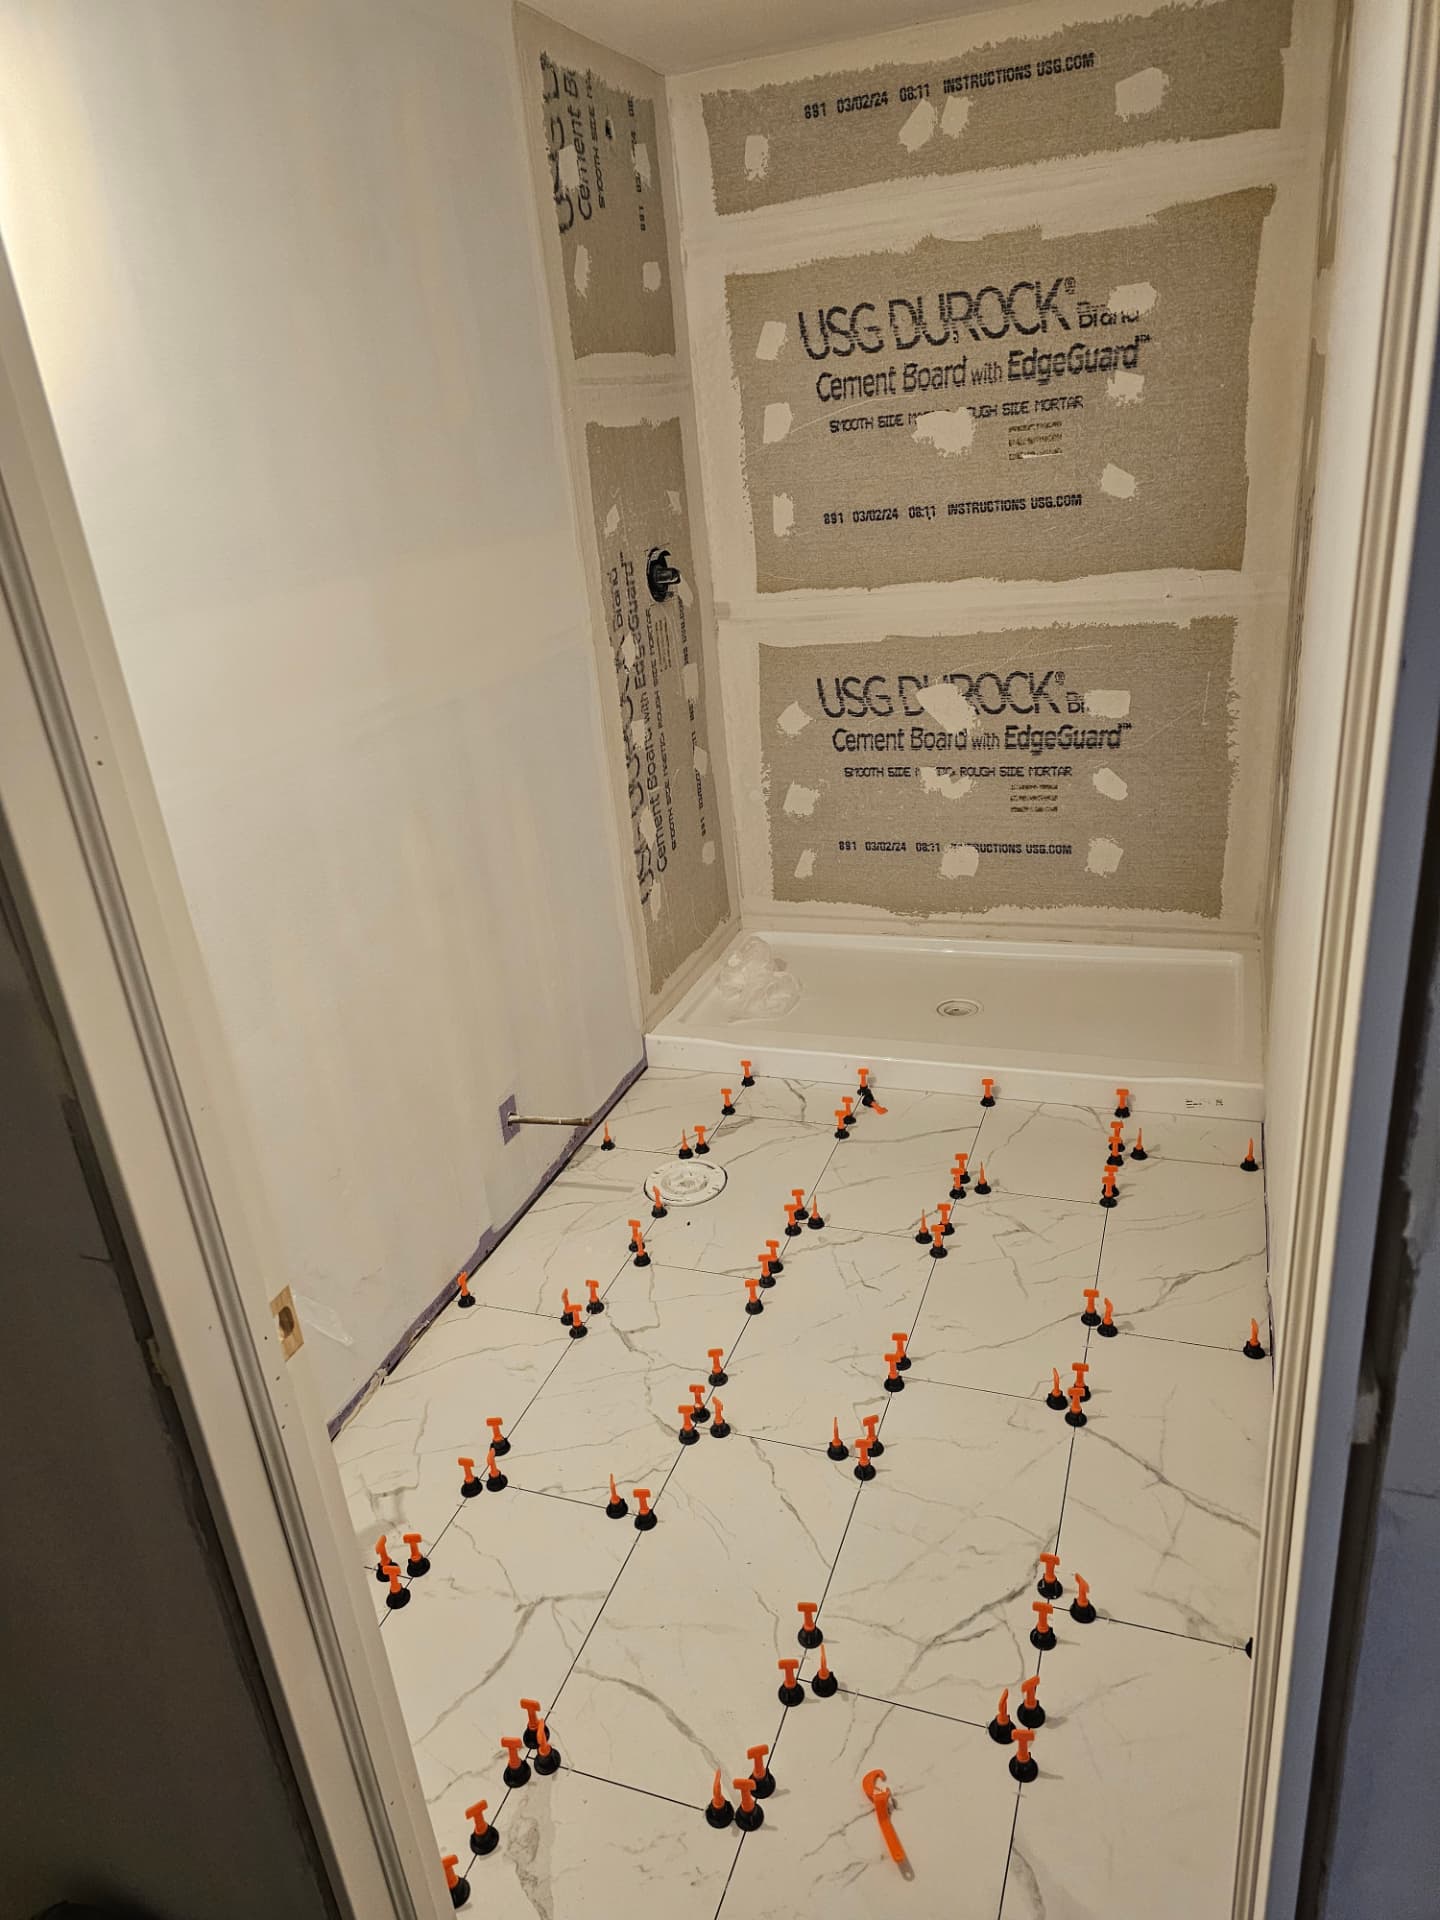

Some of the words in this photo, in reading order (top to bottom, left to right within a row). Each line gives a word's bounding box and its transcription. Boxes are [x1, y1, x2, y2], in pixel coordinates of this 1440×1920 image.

[837, 91, 888, 114] 03/02/24
[943, 64, 1031, 94] INSTRUCTIONS
[1037, 52, 1095, 76] USG.COM
[798, 301, 884, 361] USG
[816, 366, 896, 402] Cement
[902, 355, 967, 393] Board
[970, 361, 1003, 386] with
[829, 416, 874, 433] SMOOTH
[877, 412, 904, 428] SIDE
[1002, 402, 1030, 416] SIDE
[1035, 395, 1084, 413] MORTAR
[823, 512, 844, 525] 891
[852, 508, 899, 523] 03/02/24
[947, 498, 1027, 516] INSTRUCTIONS
[1030, 493, 1083, 510] USG.COM
[645, 608, 656, 656] MORTAR
[639, 691, 651, 724] with
[816, 674, 893, 718] USG
[831, 726, 905, 754] Cement
[909, 726, 968, 753] Board
[971, 732, 1000, 752] with
[844, 766, 884, 778] SMOOTH
[888, 766, 912, 778] SIDE
[960, 766, 995, 778] ROUGH
[999, 766, 1024, 778] SIDE
[1028, 766, 1073, 777] MORTAR
[649, 794, 668, 872] Cement
[838, 841, 857, 851] 891
[864, 841, 907, 852] 03/02/24
[1025, 844, 1073, 855] USG.COM
